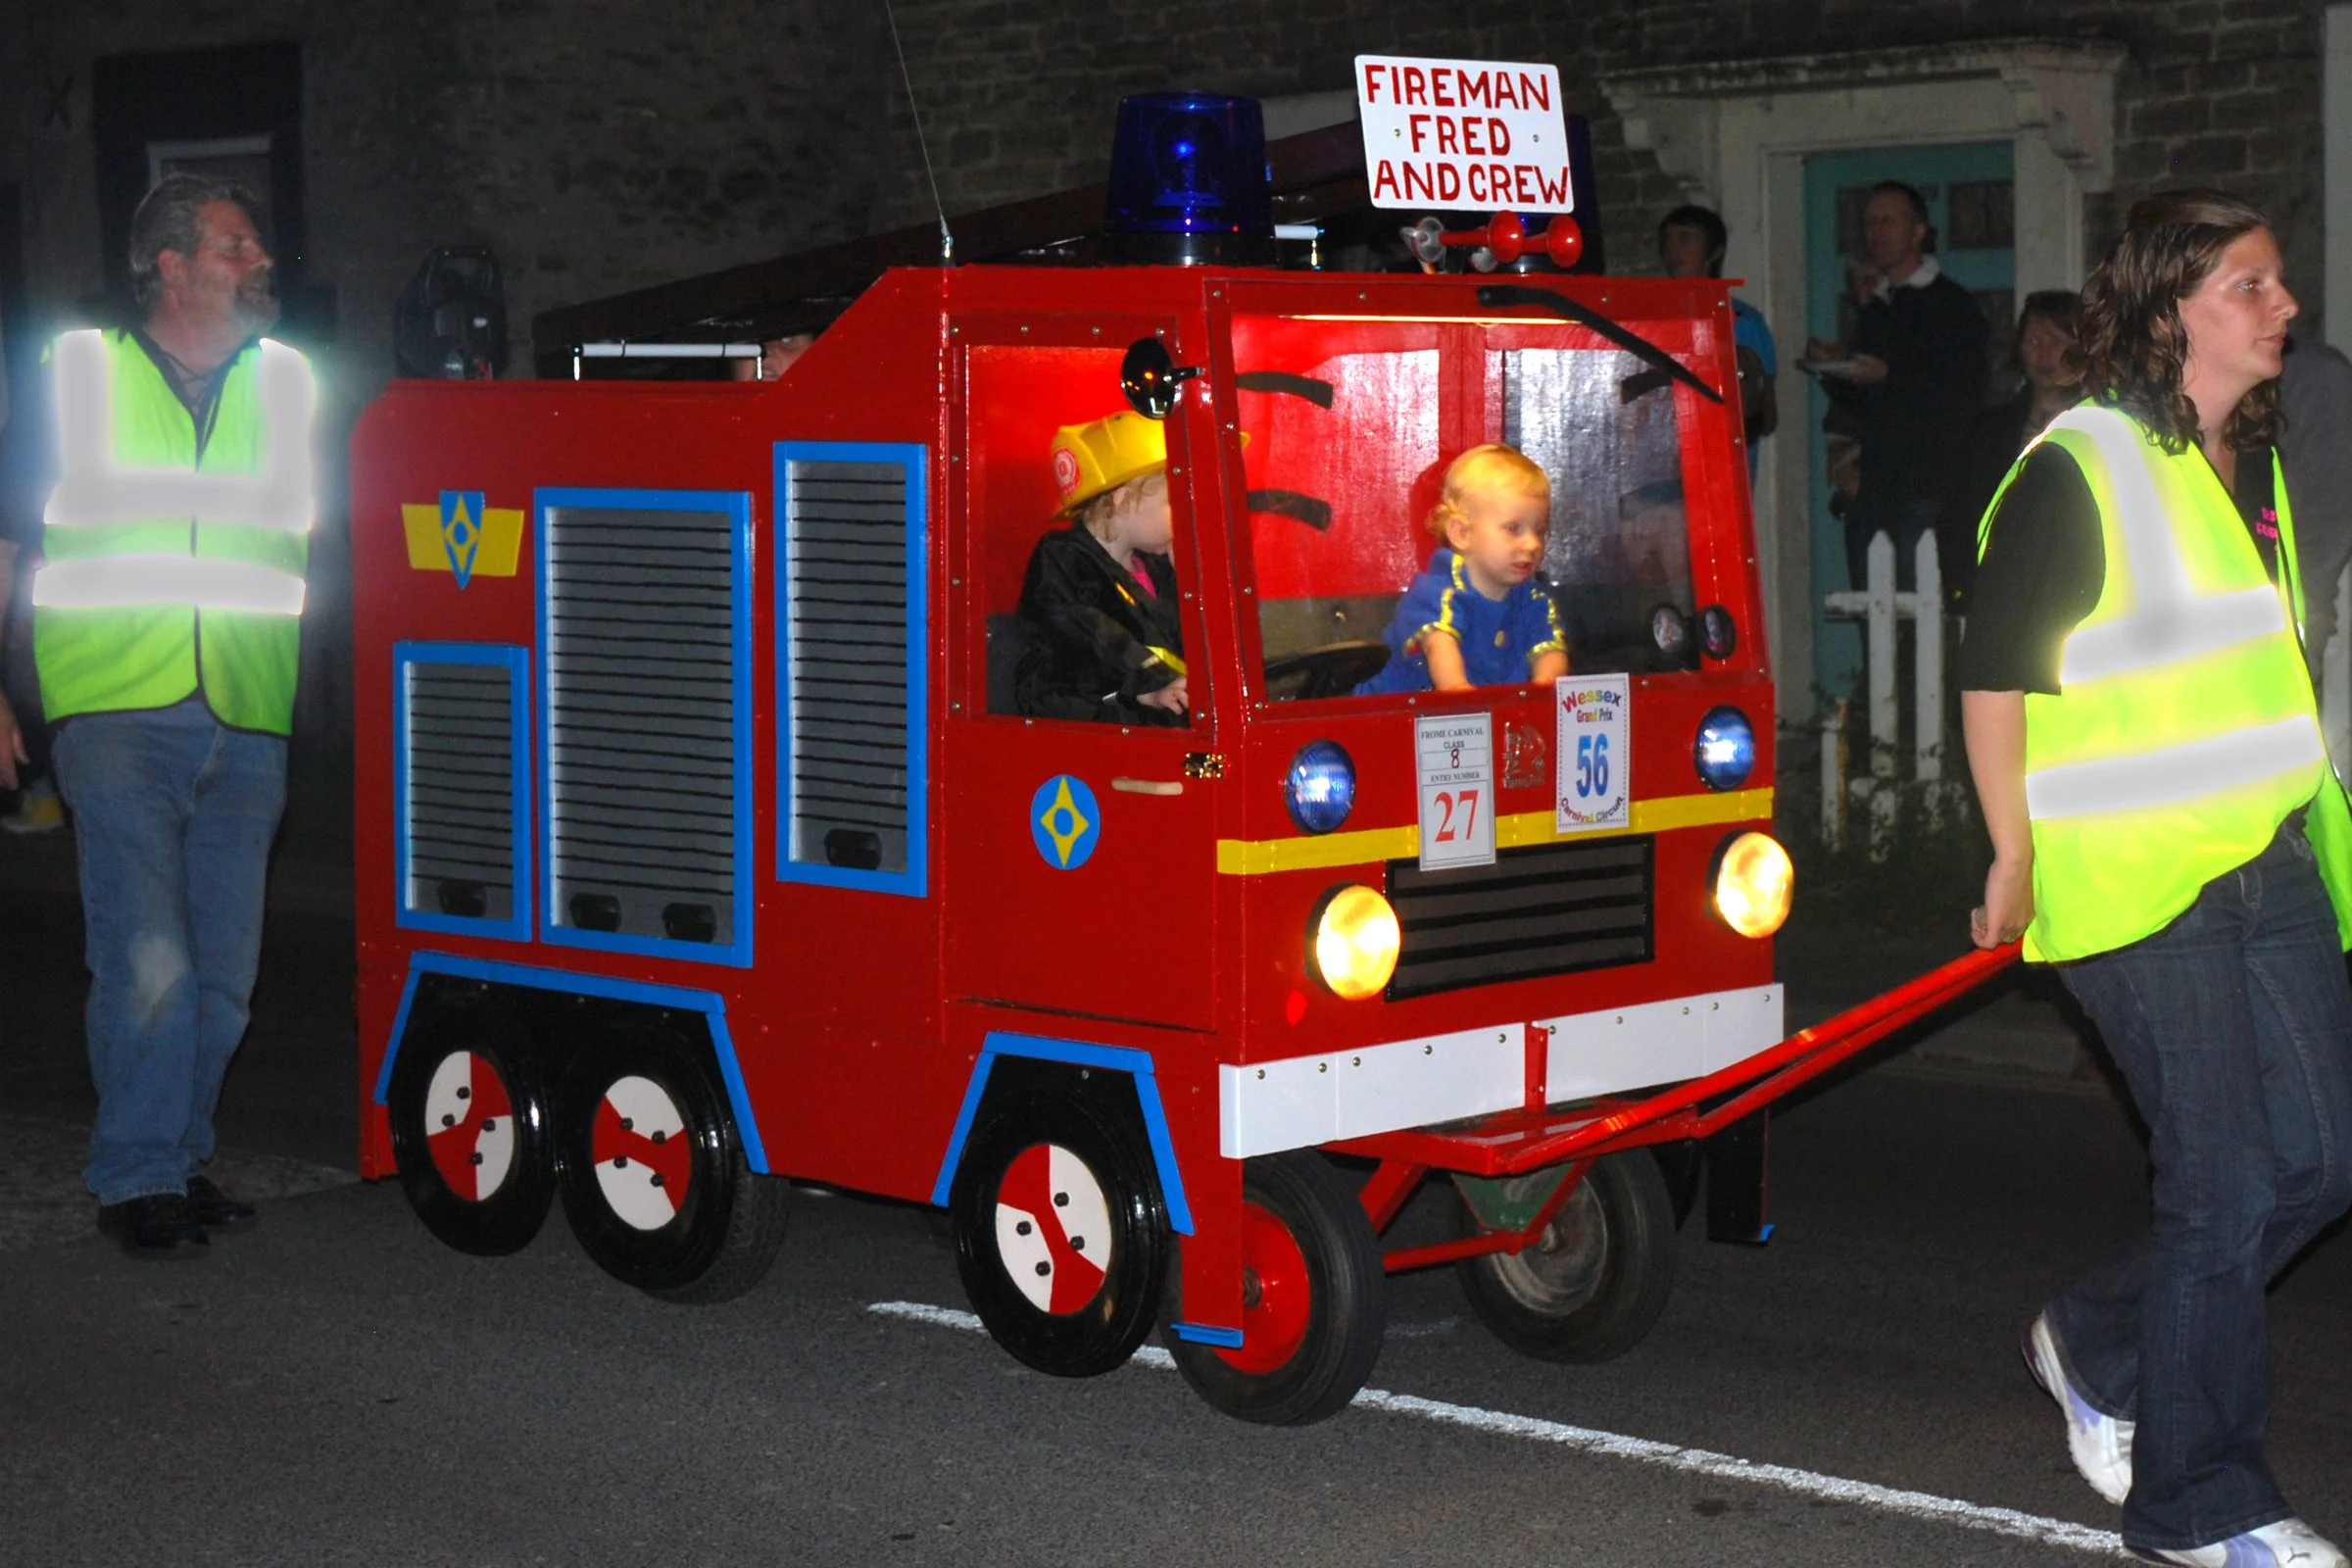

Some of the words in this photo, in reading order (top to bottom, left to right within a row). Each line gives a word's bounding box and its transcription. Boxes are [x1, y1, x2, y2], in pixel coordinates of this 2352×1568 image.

[1364, 64, 1550, 112] FIREMAN
[1409, 114, 1511, 157] FRED
[1373, 160, 1461, 201] AND
[1468, 163, 1569, 205] CREW
[1562, 689, 1622, 713] Wessex
[1576, 709, 1598, 723] Grand
[1598, 708, 1613, 722] Prix
[1421, 730, 1446, 740] FROME
[1447, 727, 1484, 738] CARNIVAL
[1444, 741, 1465, 750] CLASS
[1450, 748, 1460, 769] 8
[1576, 733, 1609, 799] 56
[1431, 773, 1451, 783] ENTRY
[1453, 771, 1480, 780] NUMBER
[1434, 789, 1479, 843] 27
[1561, 796, 1595, 824] Carnival
[1595, 795, 1625, 823] Circuit
